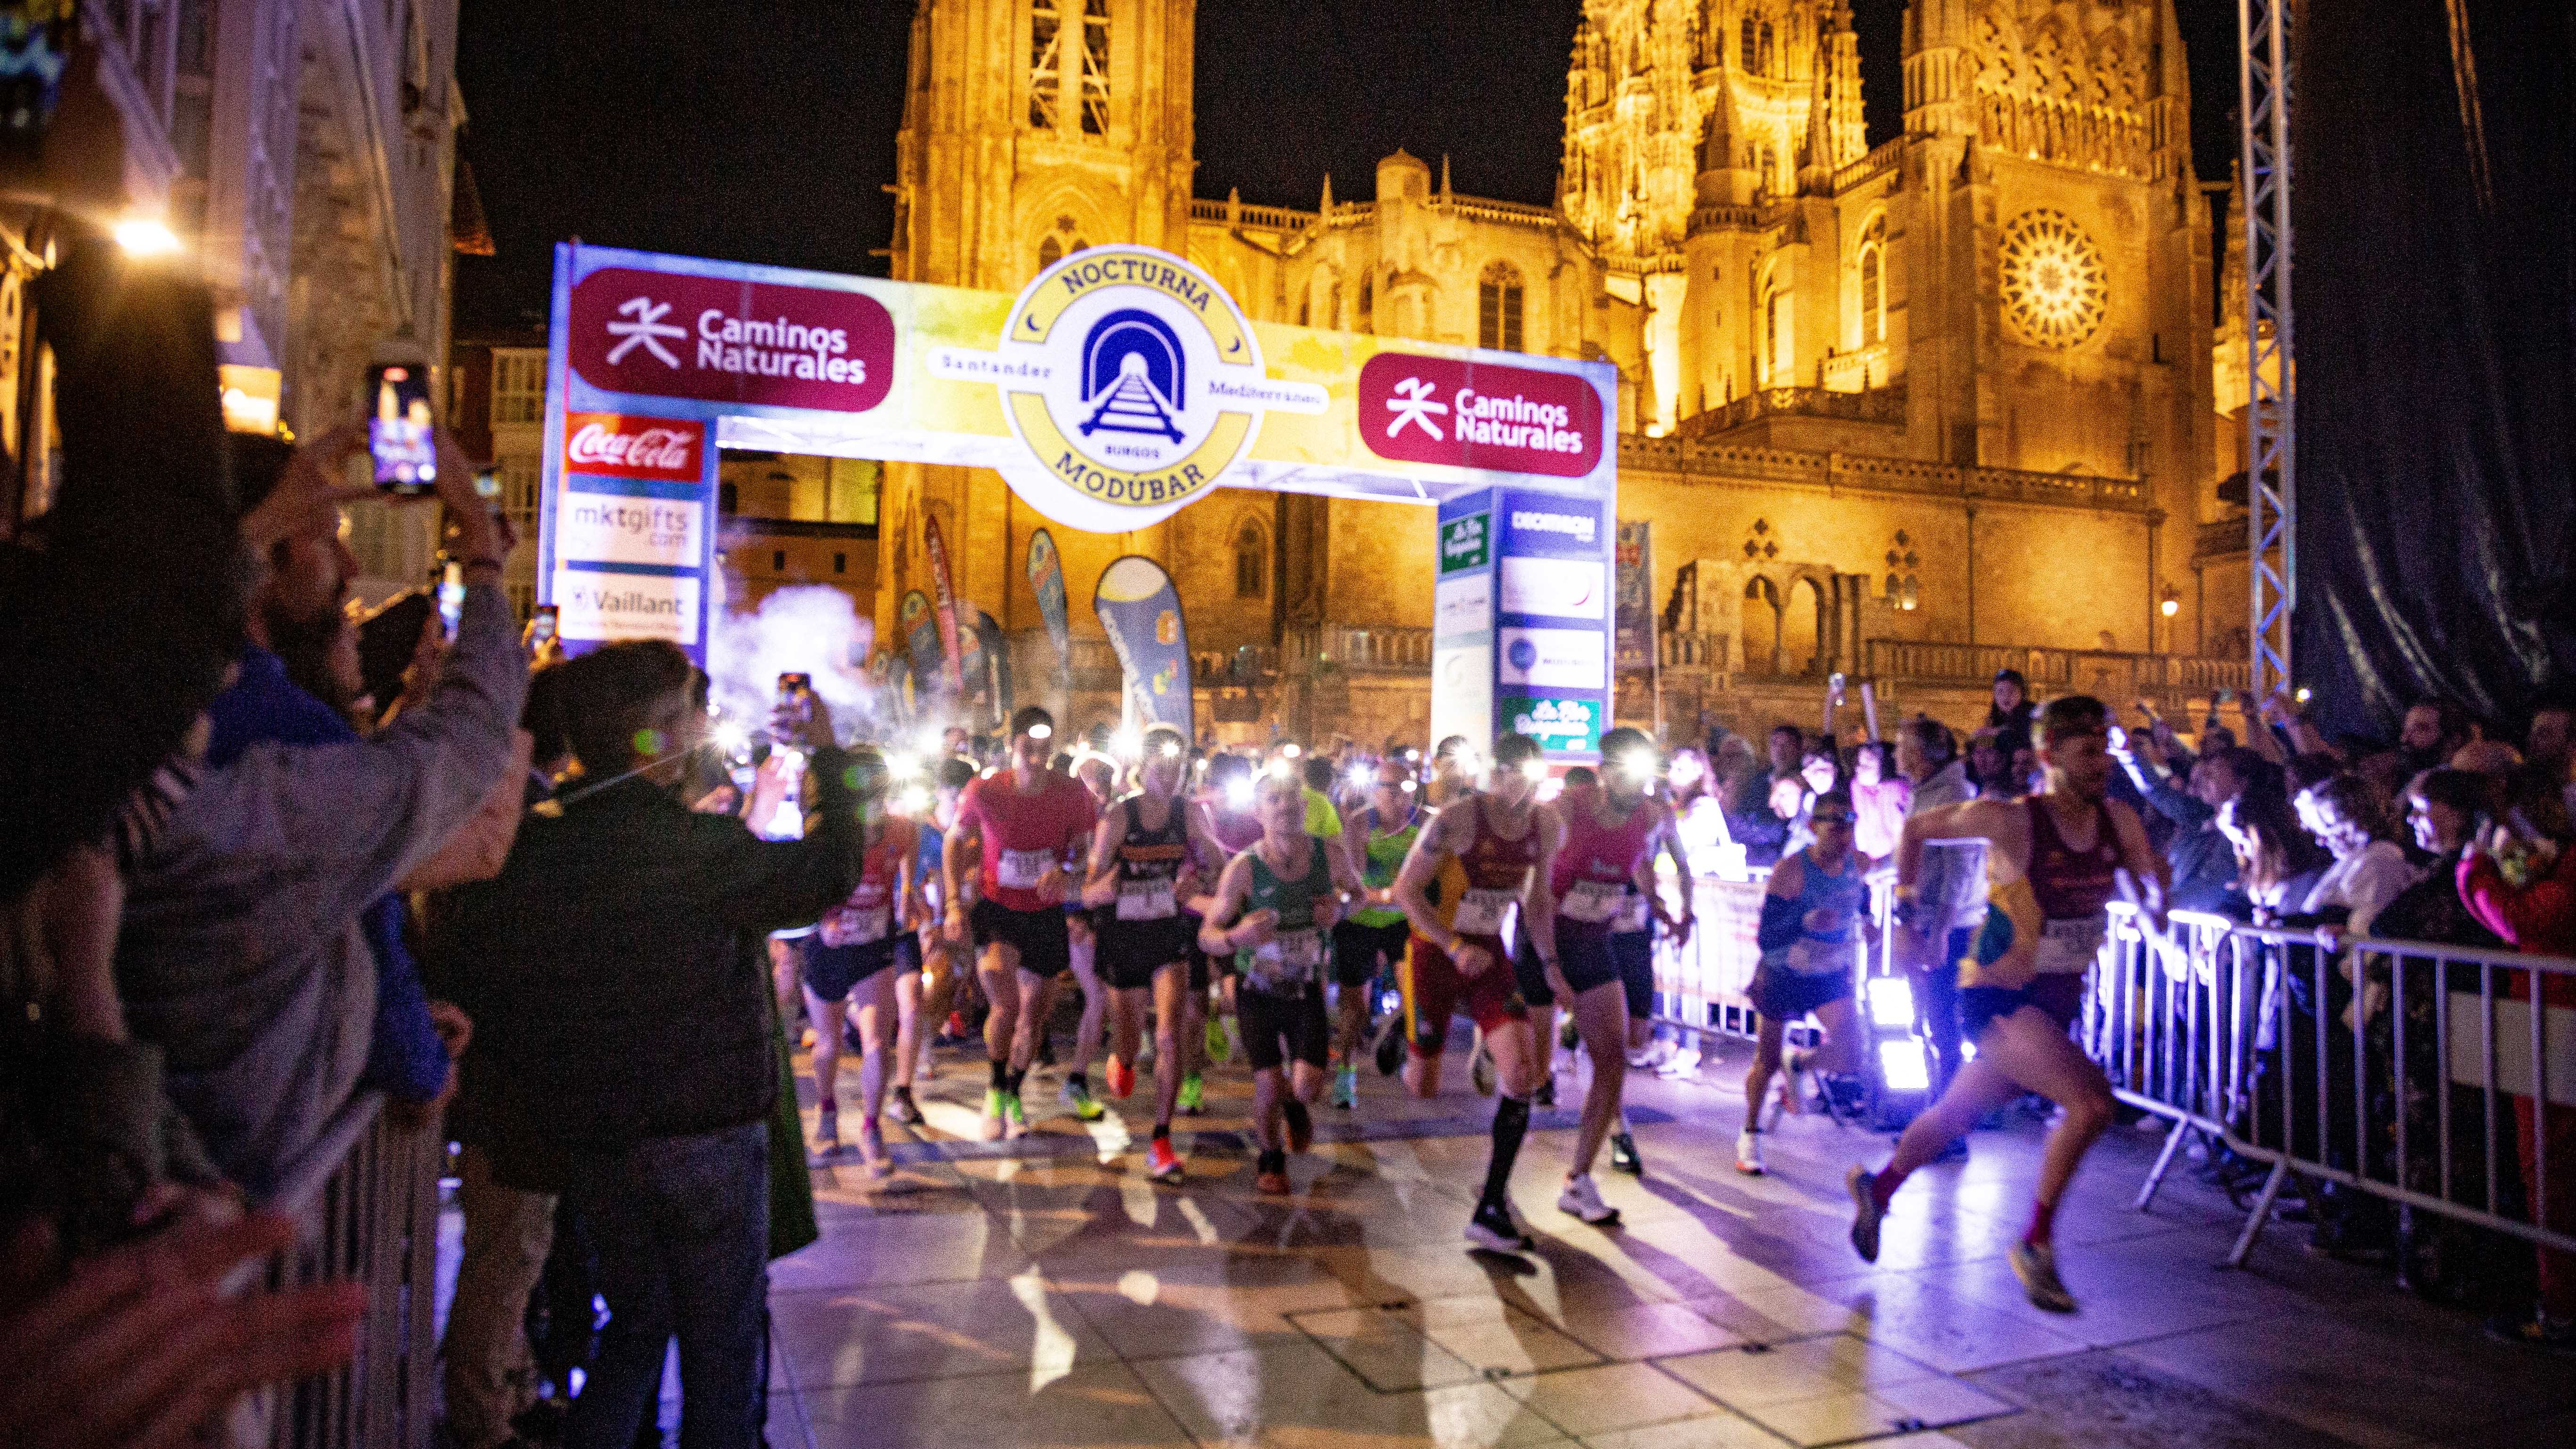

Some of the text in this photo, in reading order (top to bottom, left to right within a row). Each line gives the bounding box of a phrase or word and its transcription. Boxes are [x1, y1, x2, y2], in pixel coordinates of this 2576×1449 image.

[1061, 258, 1211, 313] NOCTURNA
[697, 308, 849, 354] Caminos
[697, 339, 866, 385] Naturales
[942, 354, 1053, 379] Santander
[1455, 387, 1569, 427] Caminos
[1104, 444, 1160, 460] BURGOS
[1455, 413, 1584, 454] Naturales
[1055, 451, 1206, 503] MODÚBAR
[575, 503, 687, 535] mktgifts
[593, 589, 684, 616] Vaillant
